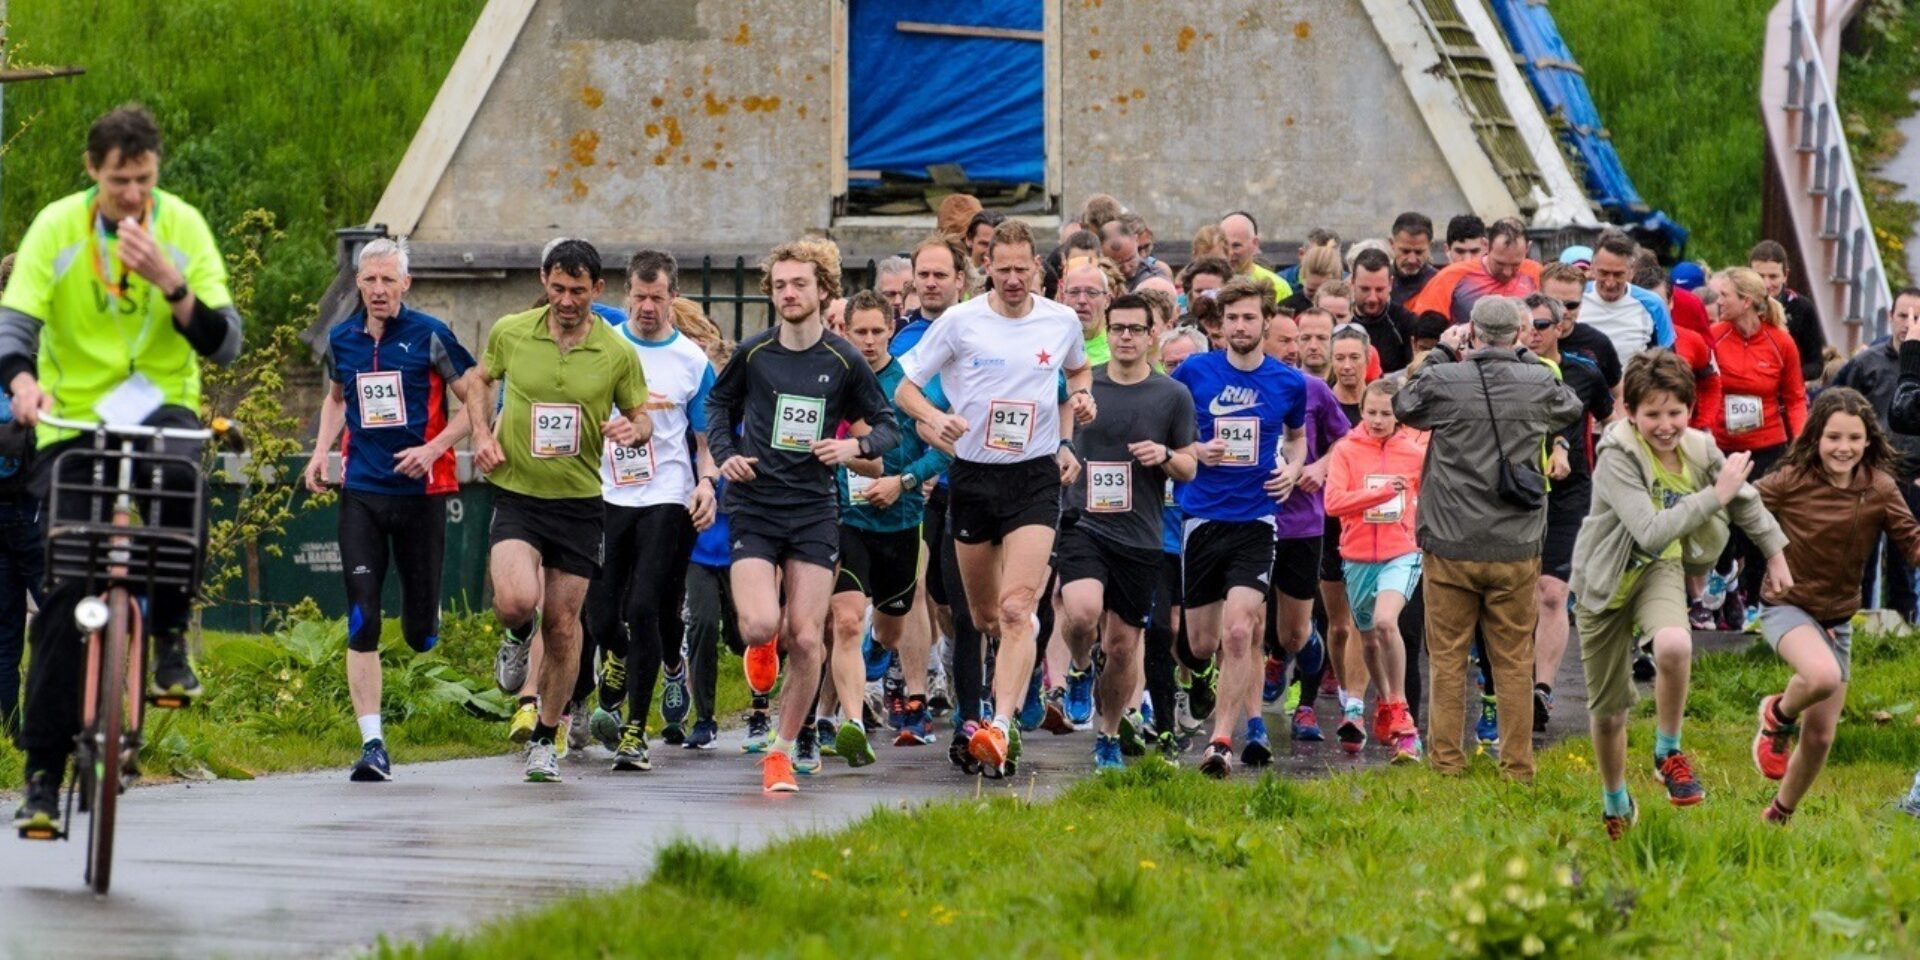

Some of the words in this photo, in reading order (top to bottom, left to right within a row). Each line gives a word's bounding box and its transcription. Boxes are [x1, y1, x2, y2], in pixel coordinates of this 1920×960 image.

[363, 384, 397, 399] 931
[1219, 384, 1260, 405] RUN
[783, 407, 818, 423] 528
[1731, 403, 1757, 414] 503
[538, 415, 573, 430] 927
[995, 410, 1029, 426] 917
[1221, 428, 1253, 441] 914
[614, 447, 647, 460] 956
[1093, 472, 1125, 486] 933
